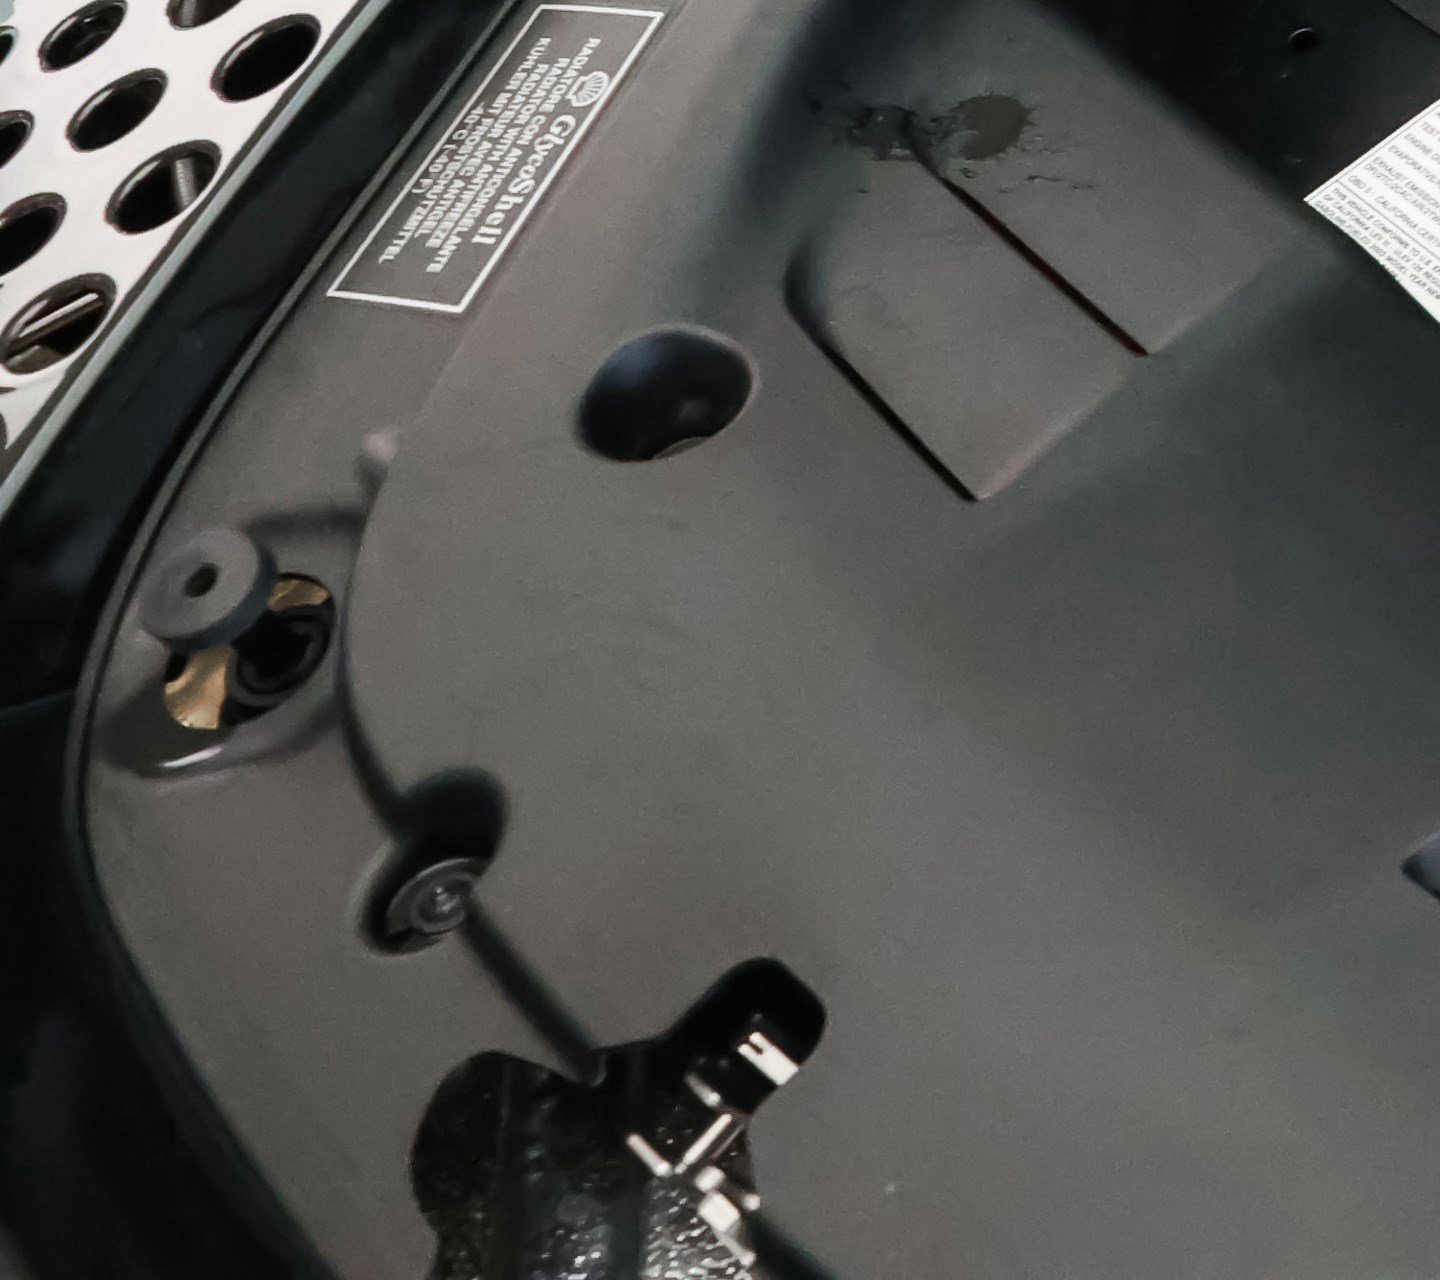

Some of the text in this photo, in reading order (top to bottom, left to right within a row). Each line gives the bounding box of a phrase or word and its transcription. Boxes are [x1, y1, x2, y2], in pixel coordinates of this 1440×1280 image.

[486, 92, 513, 112] MIT
[1403, 132, 1433, 155] ENGINE
[1418, 121, 1440, 137] TEST
[412, 63, 550, 239] RADIATEUR AVEC ANTIGEL
[424, 57, 571, 247] RADIATOR WITH ANTIFREEZE
[424, 37, 602, 273] RADIATORE CON ANTICONGELANTE
[1372, 156, 1407, 182] EXHAUST
[465, 114, 581, 245] GlycoShell
[1346, 199, 1375, 221] VEHICLE
[1371, 218, 1411, 249] CONFORMS
[1374, 195, 1419, 230] CALIFORNIA
